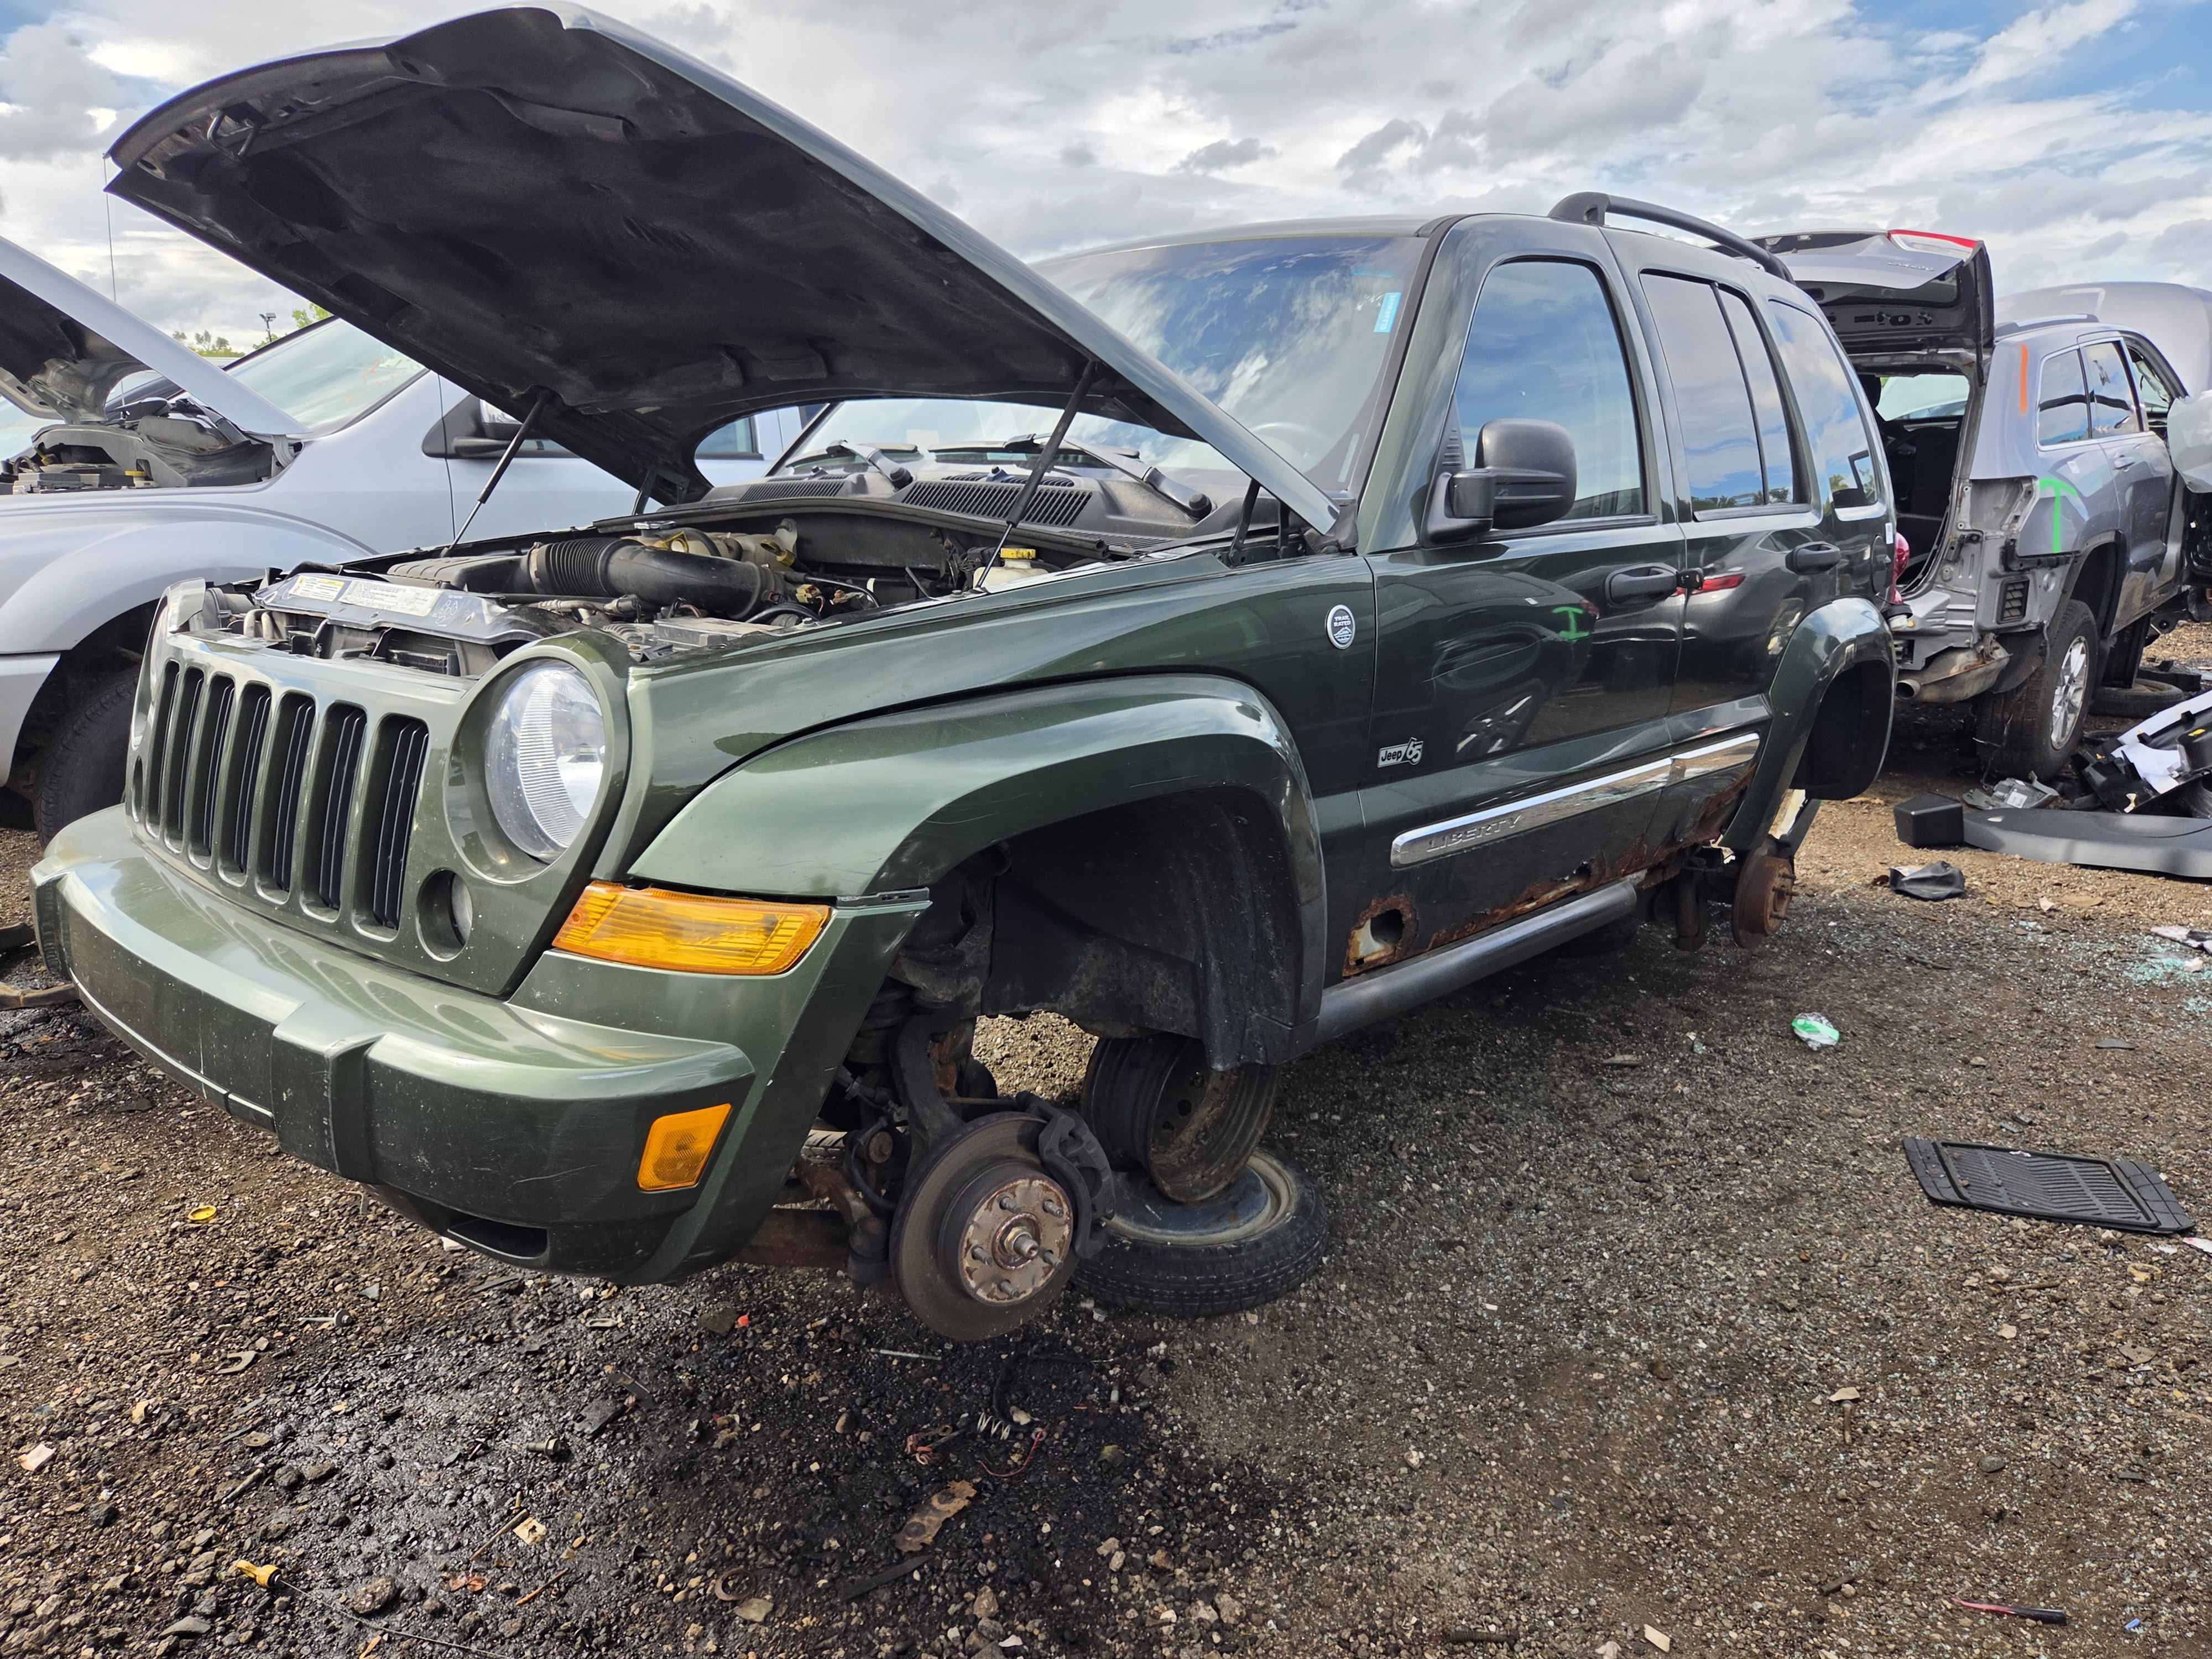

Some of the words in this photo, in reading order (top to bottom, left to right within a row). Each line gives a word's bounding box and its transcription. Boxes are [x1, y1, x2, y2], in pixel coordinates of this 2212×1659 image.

[1381, 750, 1402, 762] Jeep
[1406, 740, 1422, 763] 65
[1426, 815, 1521, 852] LIBERTY
